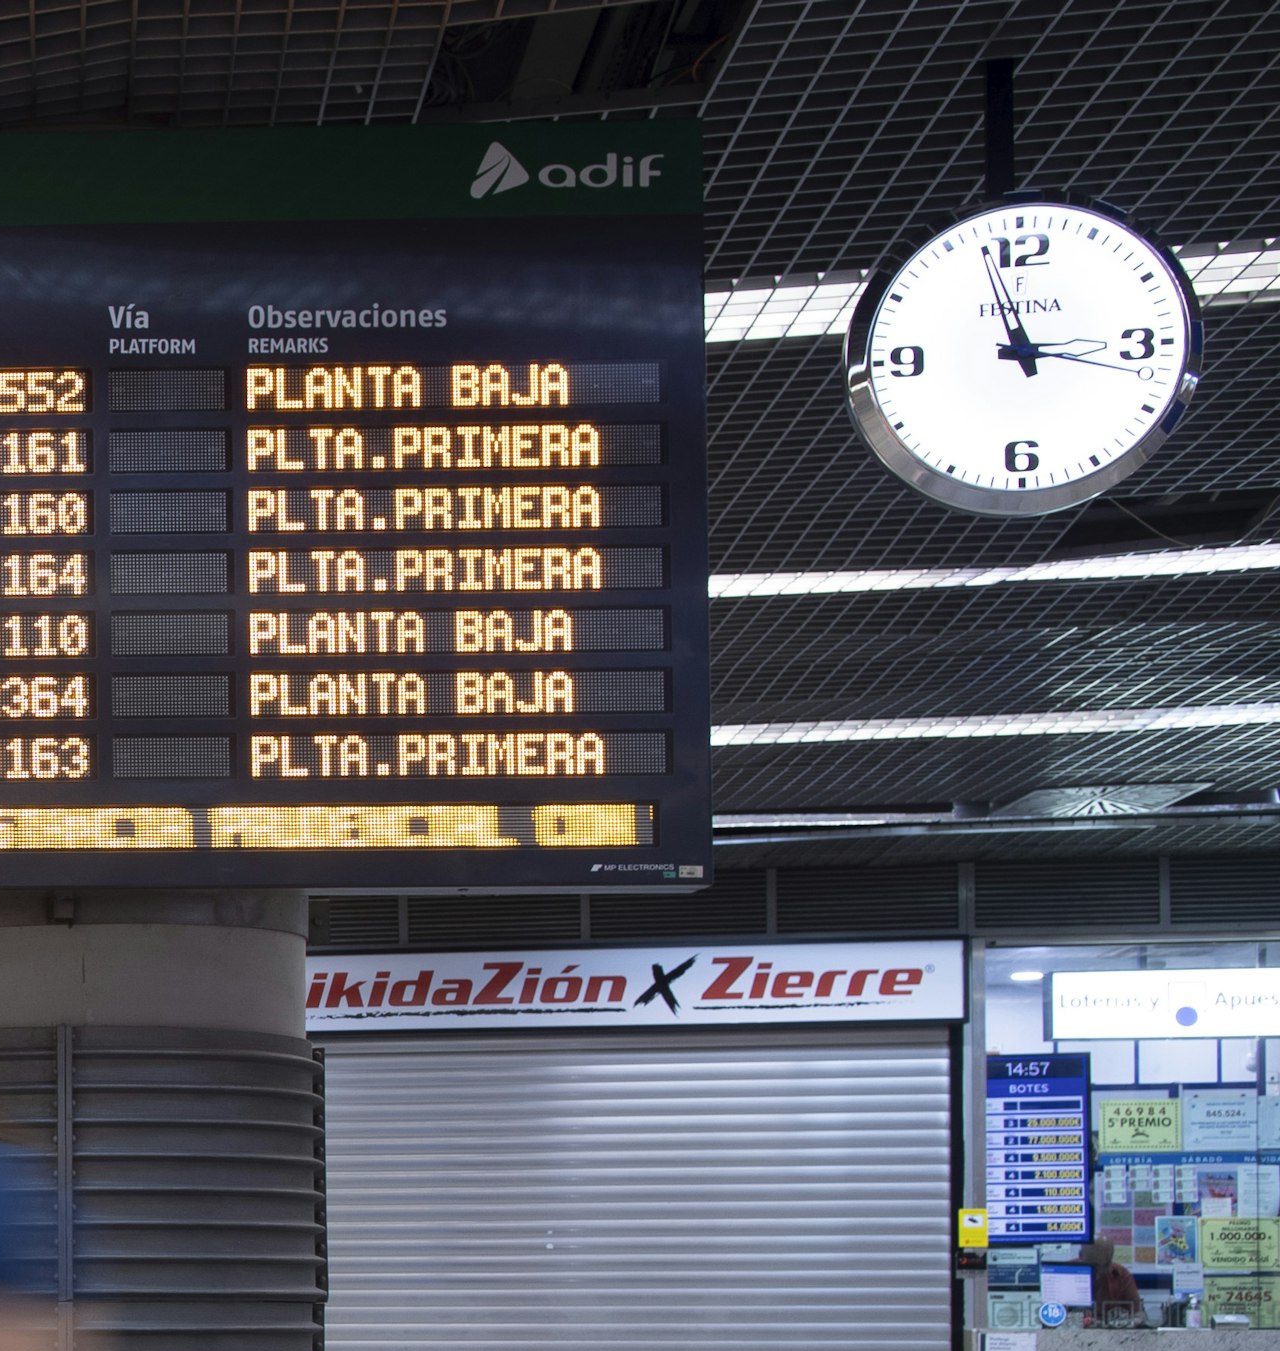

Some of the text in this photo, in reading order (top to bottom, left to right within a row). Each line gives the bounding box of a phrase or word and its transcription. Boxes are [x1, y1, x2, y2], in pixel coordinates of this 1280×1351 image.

[539, 153, 664, 187] adif
[991, 234, 1050, 268] 12
[109, 304, 148, 328] Vía
[249, 303, 446, 328] Observaciones
[979, 298, 1062, 317] FESTINA
[110, 339, 195, 354] PLATFORM
[249, 338, 328, 353] REMARKS
[1120, 328, 1154, 360] 3
[890, 346, 924, 377] 9
[246, 366, 421, 409] PLANTA
[452, 363, 569, 406] BAJA
[247, 424, 599, 470] PLTA.PRIMERA
[1005, 440, 1039, 472] 6
[248, 485, 600, 531] PLTA.PRIMERA
[248, 547, 601, 593] PLTA.PRIMERA
[249, 611, 424, 654] PLANTA
[456, 609, 572, 652] BAJA
[250, 673, 425, 716] PLANTA
[456, 671, 573, 714] BAJA
[251, 732, 604, 777] PLTA.PRIMERA
[1006, 1062, 1050, 1076] 14:57
[1009, 1084, 1049, 1094] BOTES
[1121, 1117, 1171, 1128] PREMIO
[1226, 1291, 1272, 1302] 74645
